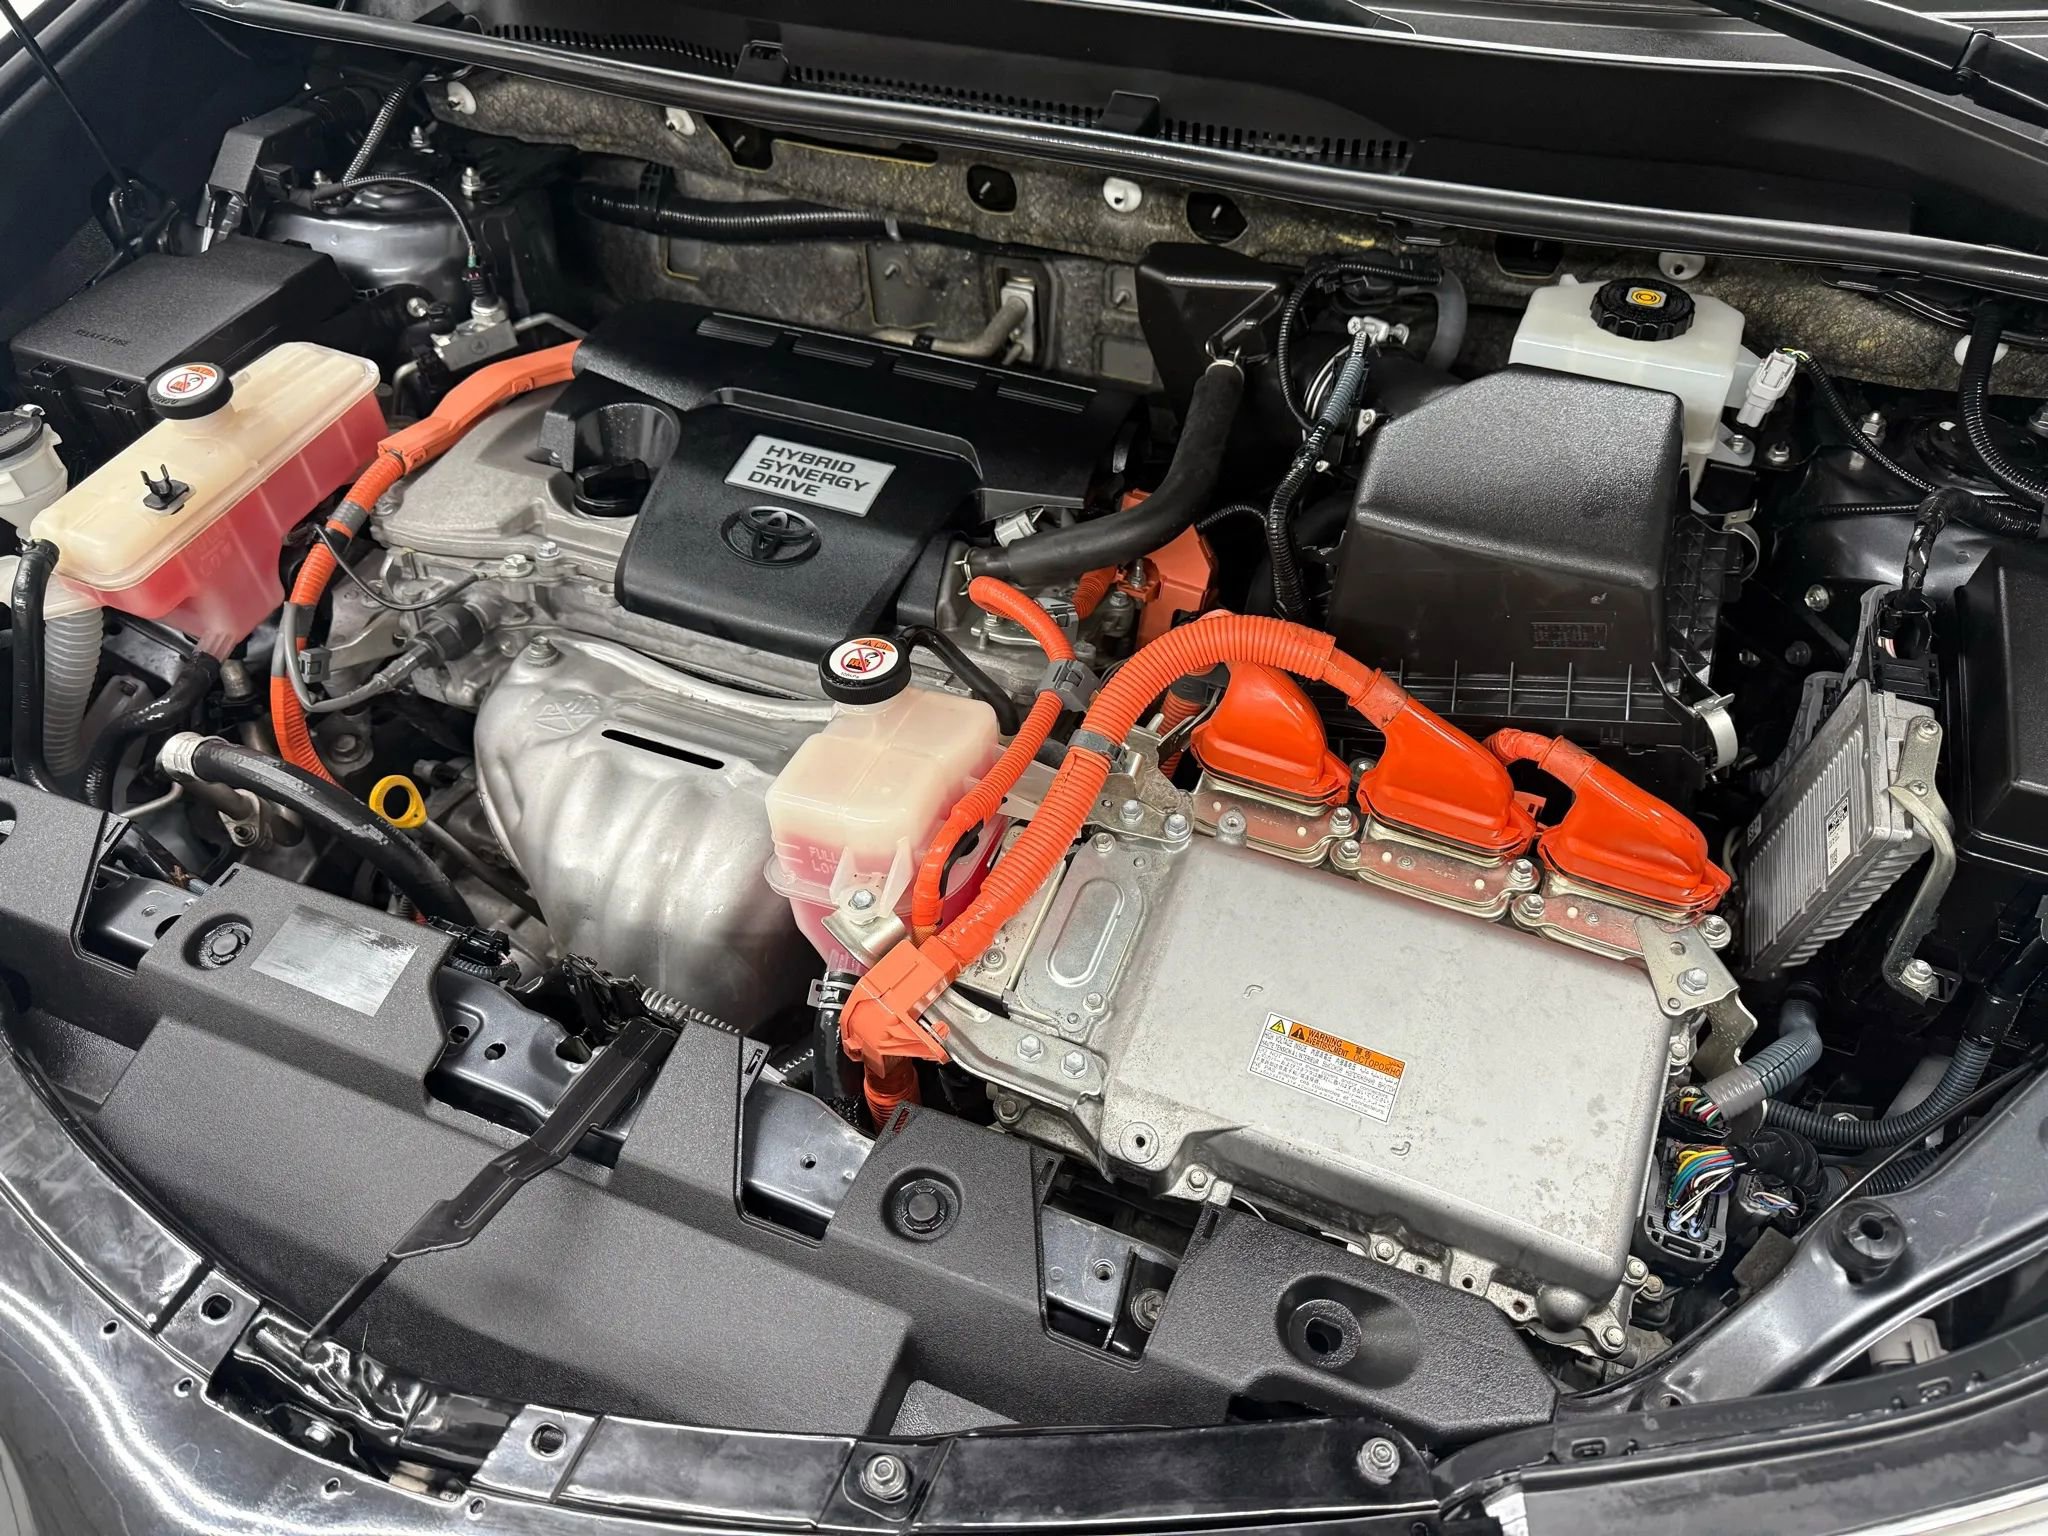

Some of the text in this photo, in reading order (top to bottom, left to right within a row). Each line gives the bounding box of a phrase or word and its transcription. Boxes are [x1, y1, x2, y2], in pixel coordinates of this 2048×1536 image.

[766, 445, 856, 474] HYBRID
[747, 471, 821, 498] DRIVE
[756, 458, 871, 493] SYNERGY
[808, 846, 838, 864] FULL
[1305, 1035, 1348, 1057] AVERTISSEMENT
[1307, 1029, 1342, 1047] WARNING
[1352, 1053, 1401, 1077] ОСТОРОЖНО
